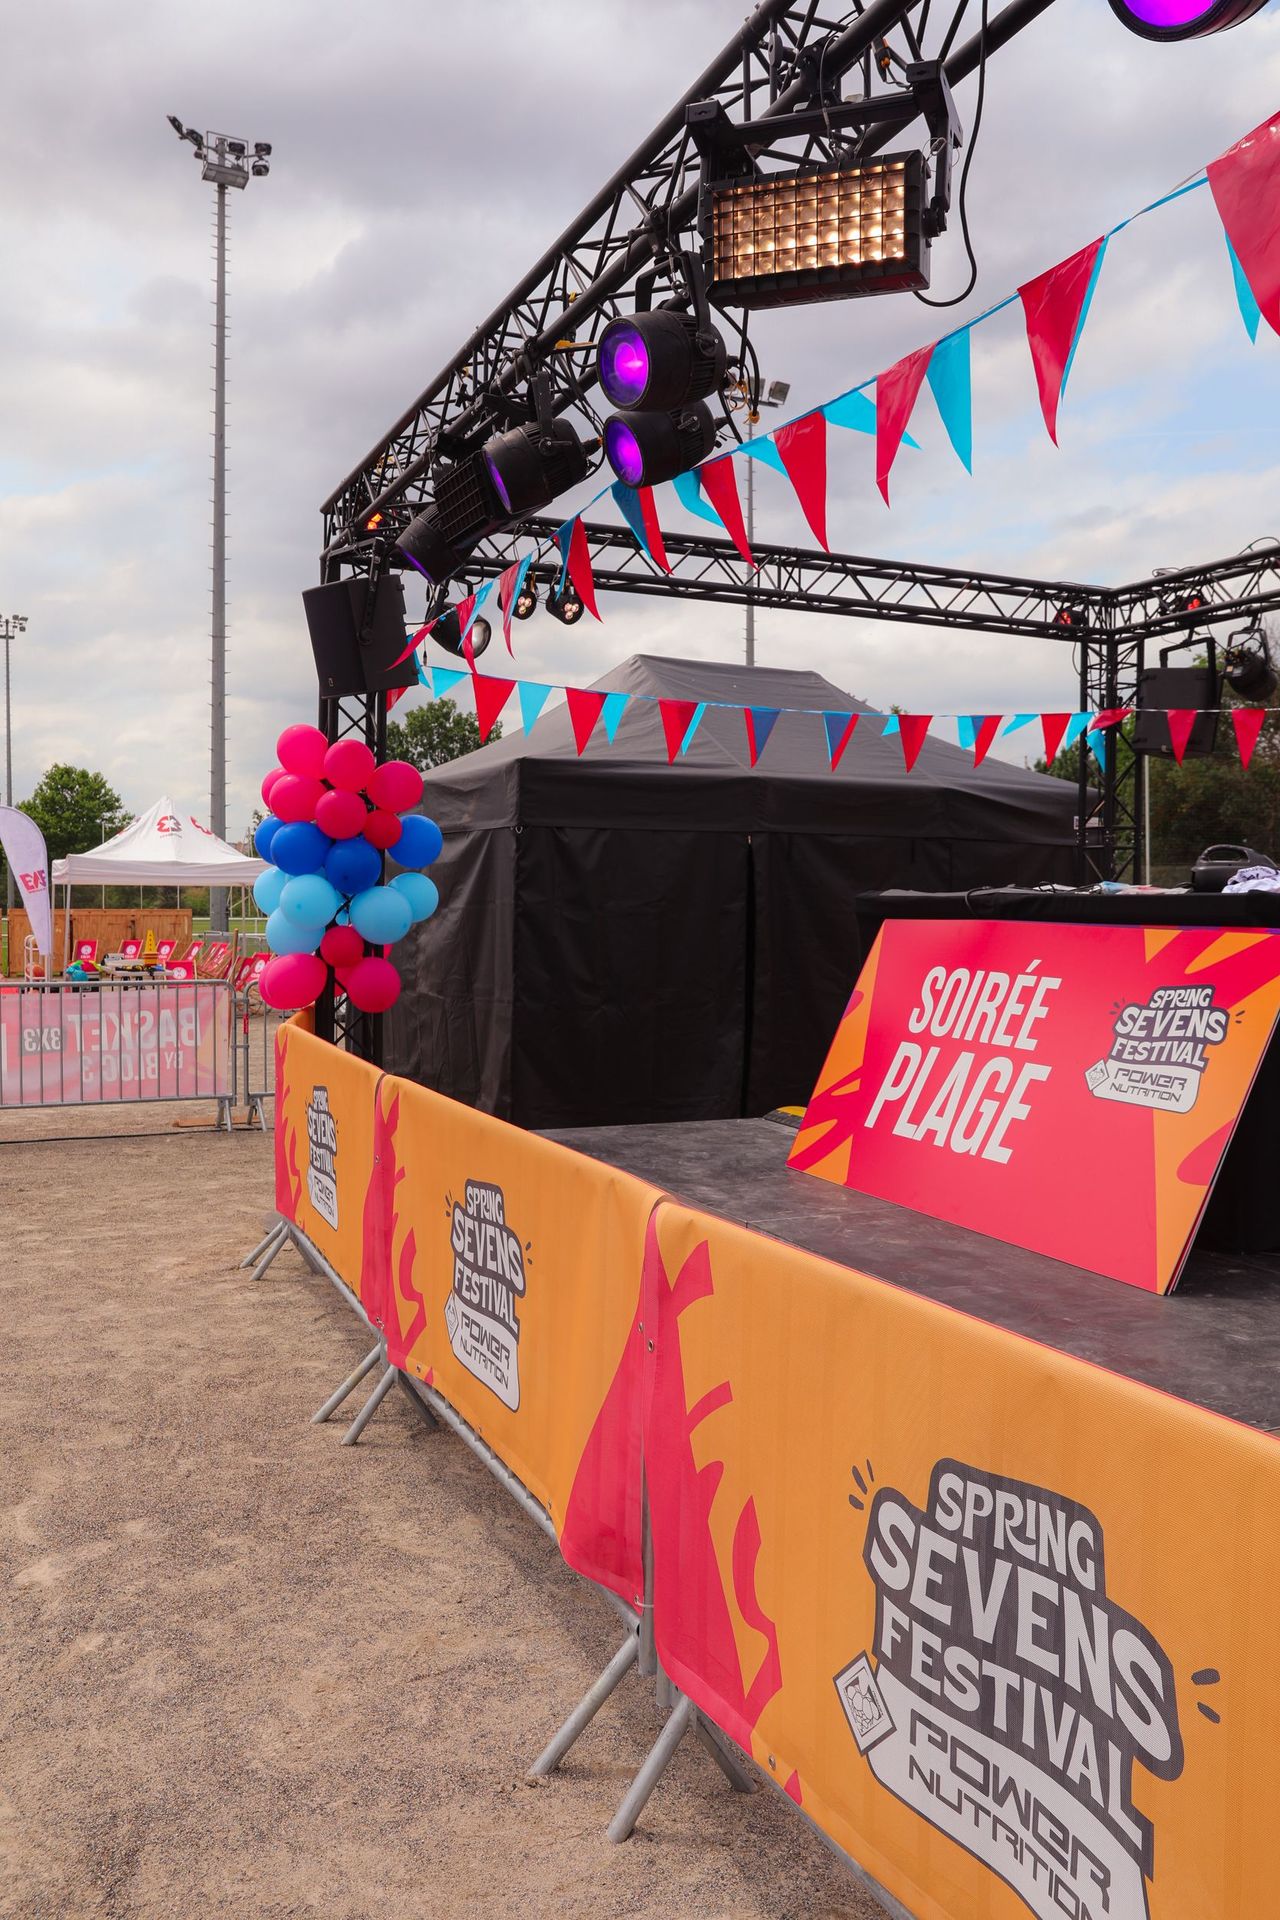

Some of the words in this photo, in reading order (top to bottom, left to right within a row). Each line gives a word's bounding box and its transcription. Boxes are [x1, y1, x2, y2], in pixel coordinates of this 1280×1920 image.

[908, 959, 1062, 1051] SOIRÉE
[1115, 1006, 1226, 1042] SEVENS
[1150, 988, 1212, 1009] SPRING
[1111, 1037, 1206, 1068] FESTIVAL
[1114, 1068, 1187, 1091] POWER
[864, 1042, 1052, 1164] PLAGE
[1110, 1082, 1182, 1103] NUTRITION
[466, 1186, 503, 1225] SPRING
[452, 1207, 525, 1291] SEVENS
[455, 1257, 519, 1334] FESTIVAL
[460, 1337, 509, 1390] NUTRITION
[461, 1311, 511, 1370] POWER
[935, 1473, 1096, 1591] SPRING
[870, 1501, 1172, 1762] SEVENS
[881, 1595, 1143, 1851] FESTIVAL
[909, 1708, 1111, 1914] POWER
[909, 1755, 1095, 1920] NUTRITIO
